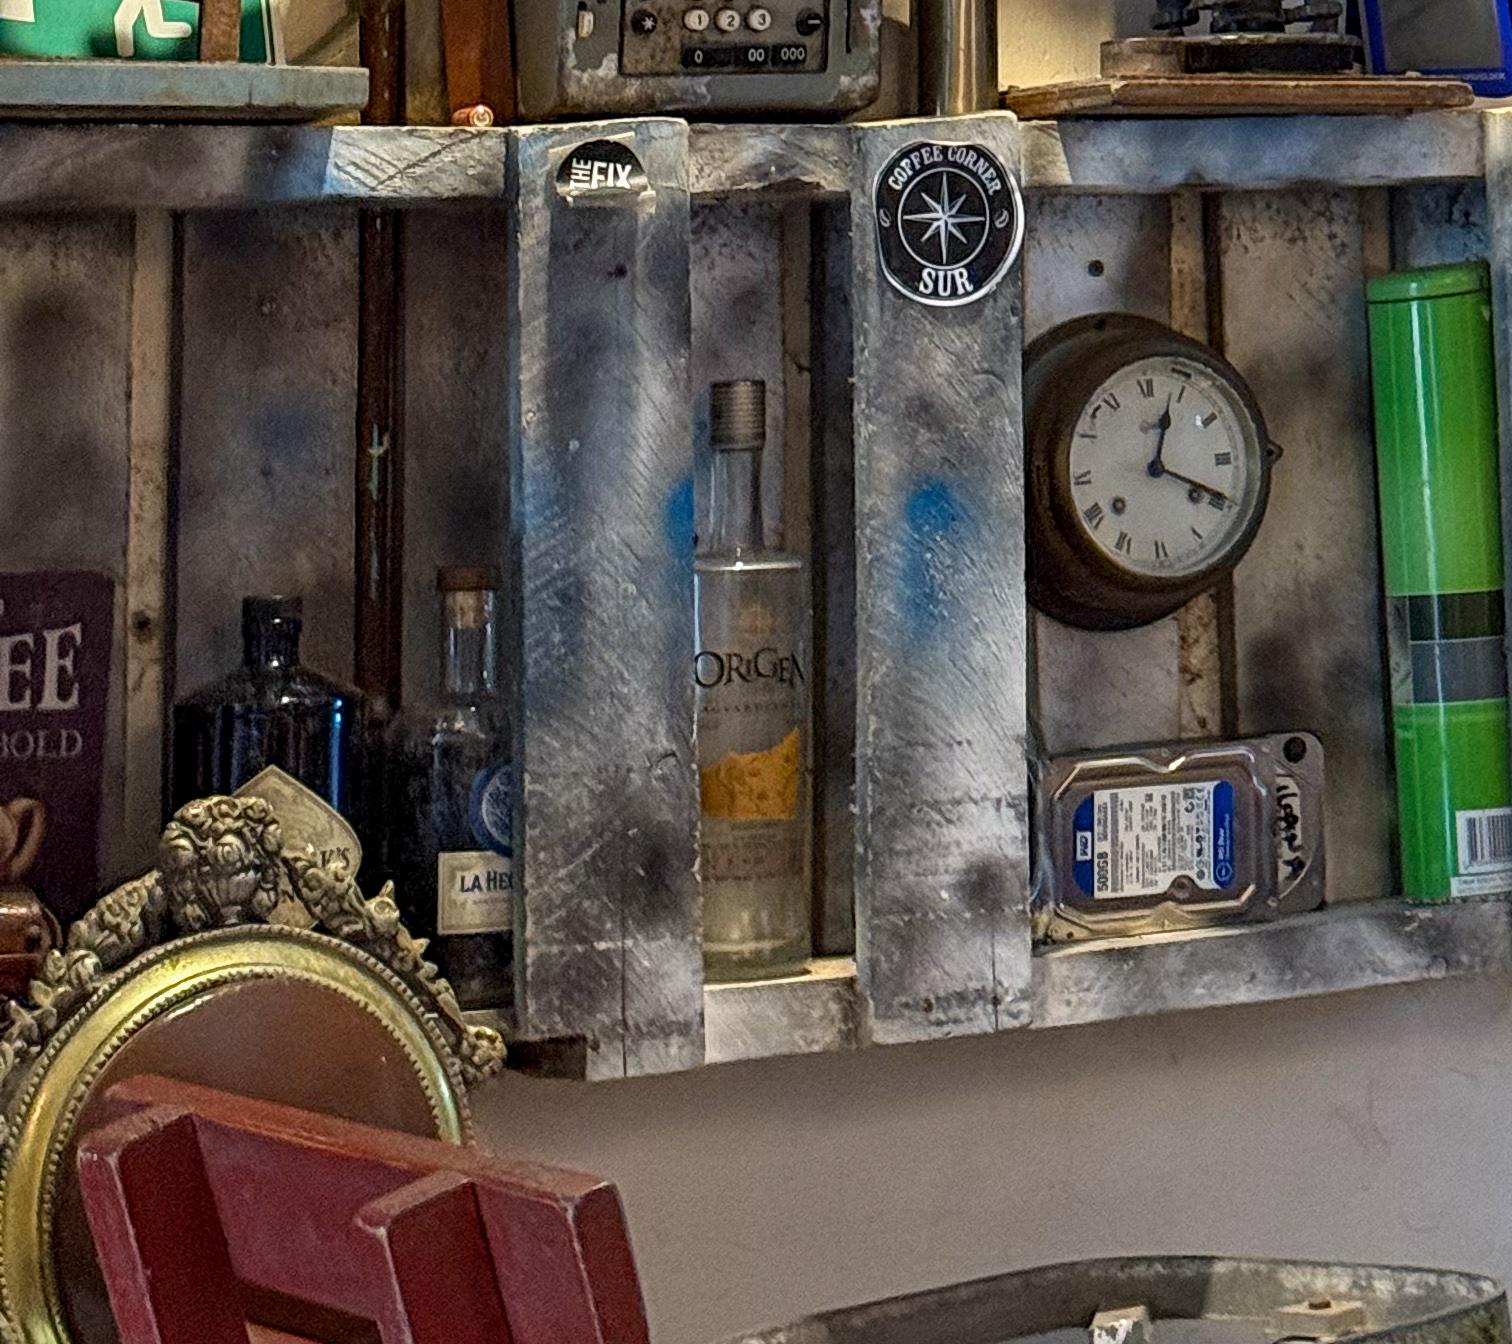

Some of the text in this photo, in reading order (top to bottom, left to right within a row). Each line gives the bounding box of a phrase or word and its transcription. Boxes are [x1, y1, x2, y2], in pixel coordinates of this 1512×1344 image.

[694, 47, 805, 64] 0 00 000
[569, 157, 632, 190] THE FIX
[888, 144, 1002, 196] COFFEE CORNER
[919, 267, 974, 296] SUR
[460, 874, 482, 893] LA
[1096, 851, 1109, 893] 500GB
